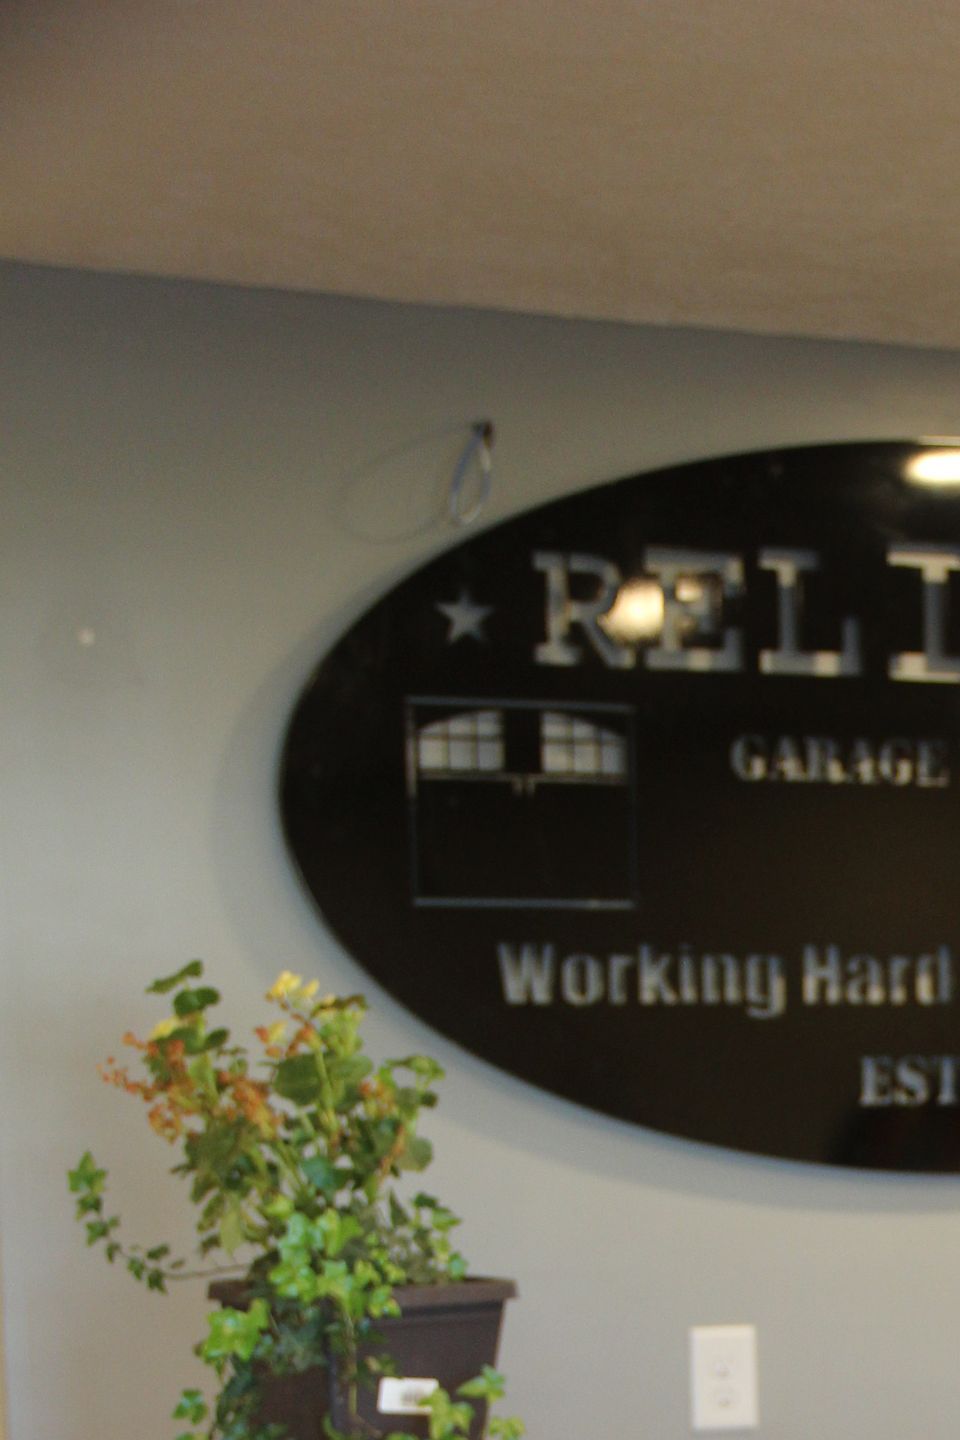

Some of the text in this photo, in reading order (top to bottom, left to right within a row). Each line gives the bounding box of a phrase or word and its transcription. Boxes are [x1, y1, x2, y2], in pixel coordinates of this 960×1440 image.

[730, 735, 950, 789] GARAGE
[498, 944, 787, 1020] Working
[801, 944, 953, 1005] Hard
